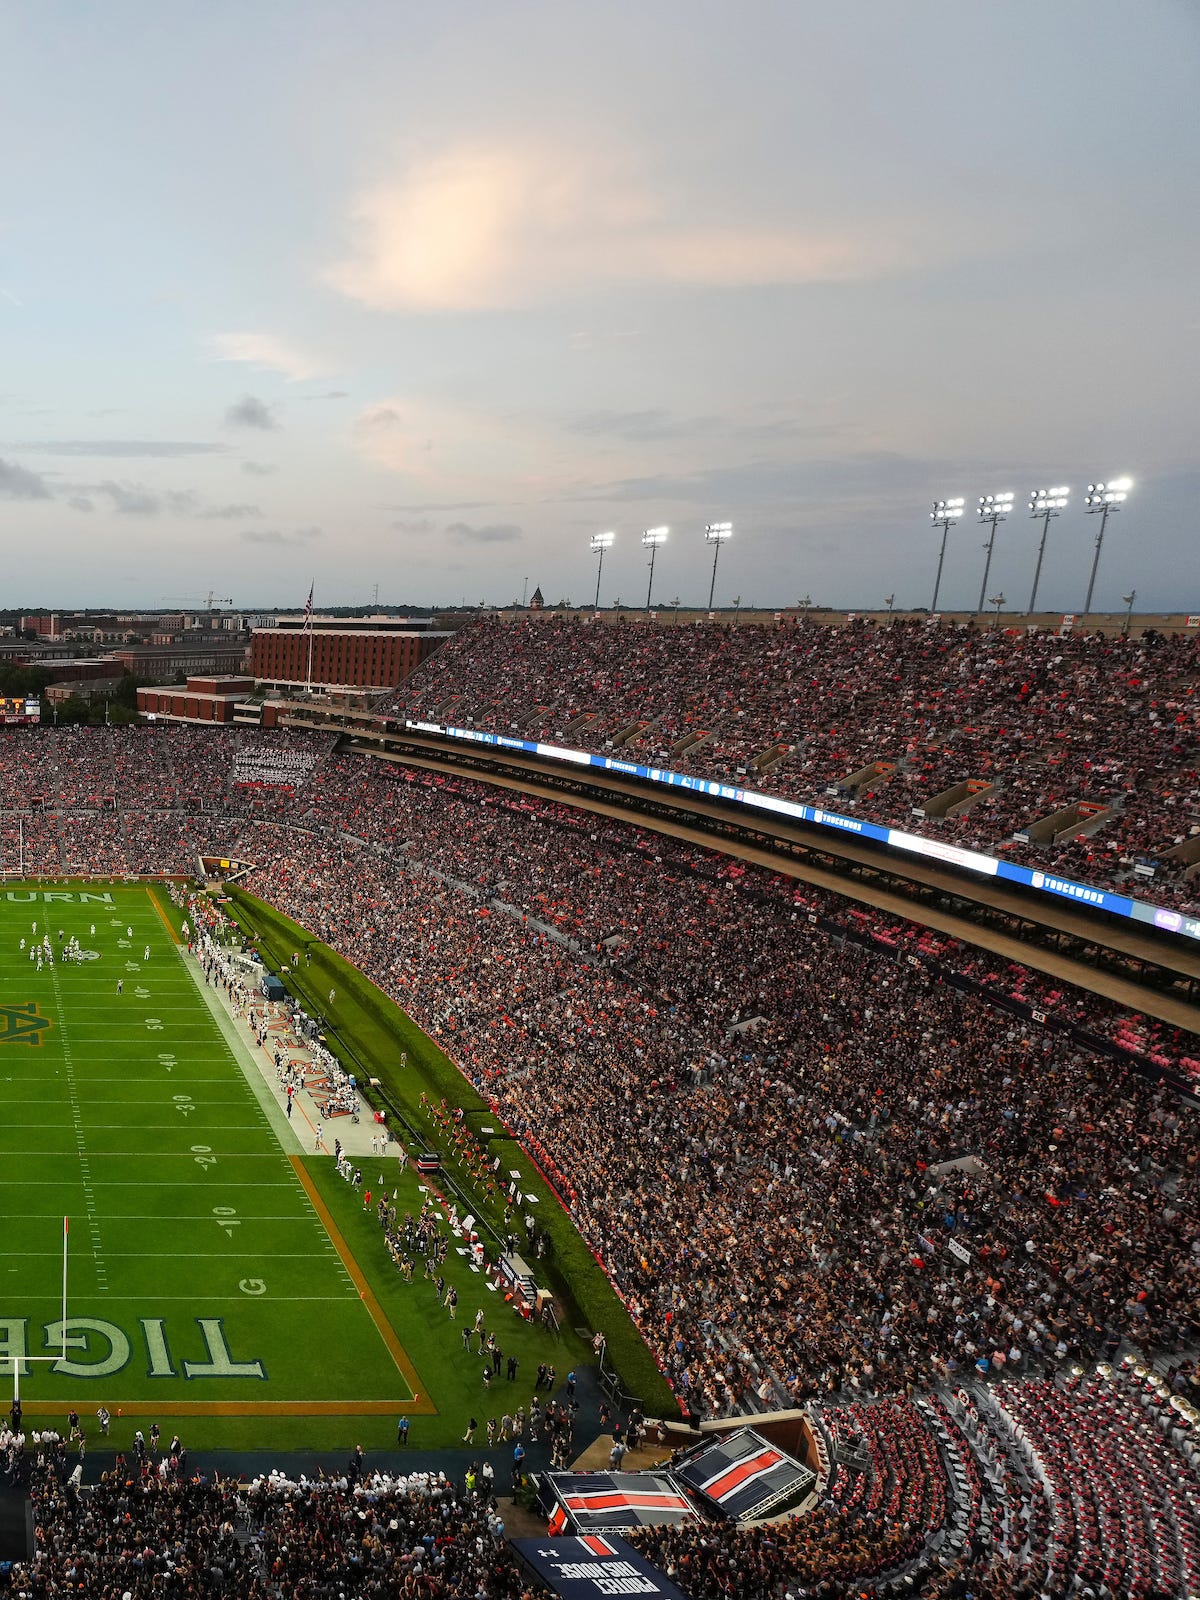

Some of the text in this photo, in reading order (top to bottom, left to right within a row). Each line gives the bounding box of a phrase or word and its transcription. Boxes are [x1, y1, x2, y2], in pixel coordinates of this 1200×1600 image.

[1045, 877, 1104, 904] TRUCKWORX
[145, 1018, 164, 1030] 50
[1033, 1012, 1044, 1021] 26
[157, 1054, 178, 1068] 40
[172, 1095, 196, 1111] 30
[190, 1145, 217, 1164] 20
[212, 1206, 241, 1226] 10
[238, 1278, 267, 1295] G
[601, 1561, 643, 1578] THIS
[591, 1577, 661, 1595] PROTECT
